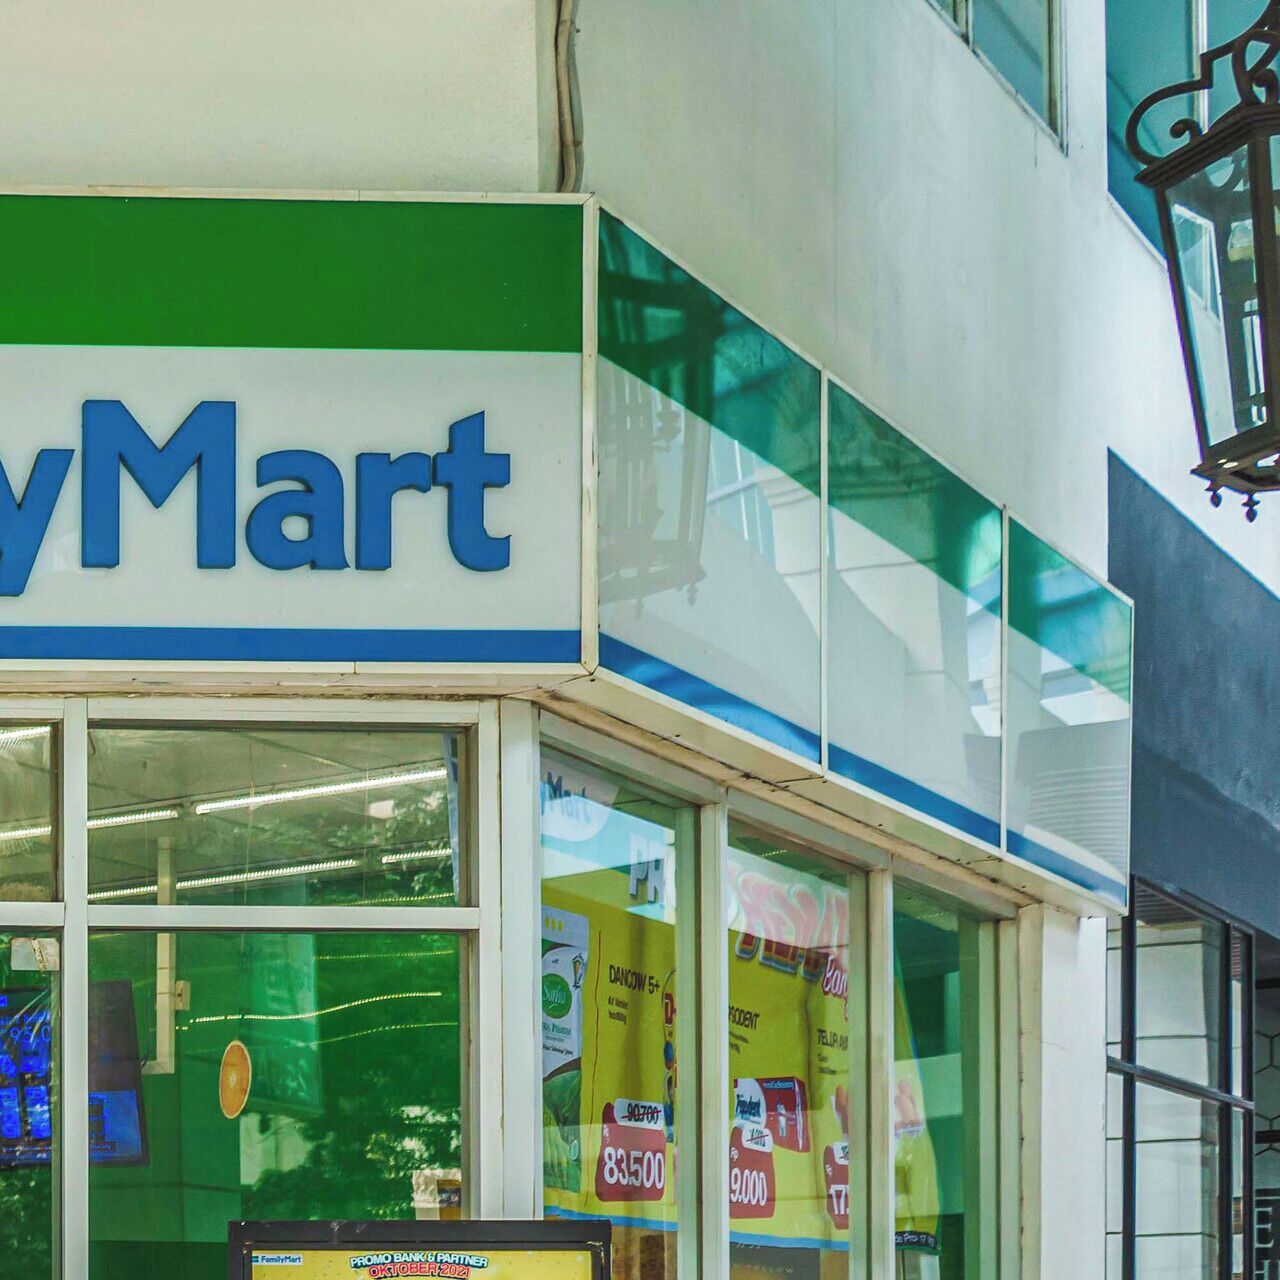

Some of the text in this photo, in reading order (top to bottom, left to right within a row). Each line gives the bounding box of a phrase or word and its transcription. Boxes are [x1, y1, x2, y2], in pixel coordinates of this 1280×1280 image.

[609, 965, 660, 994] DANCOW 5+
[624, 1102, 659, 1125] 90.700
[603, 1150, 665, 1189] 83.500
[730, 1168, 767, 1207] 9.000
[350, 1253, 488, 1268] PROMO BANK & PARTNER
[369, 1264, 470, 1280] OKTOBER 2021
